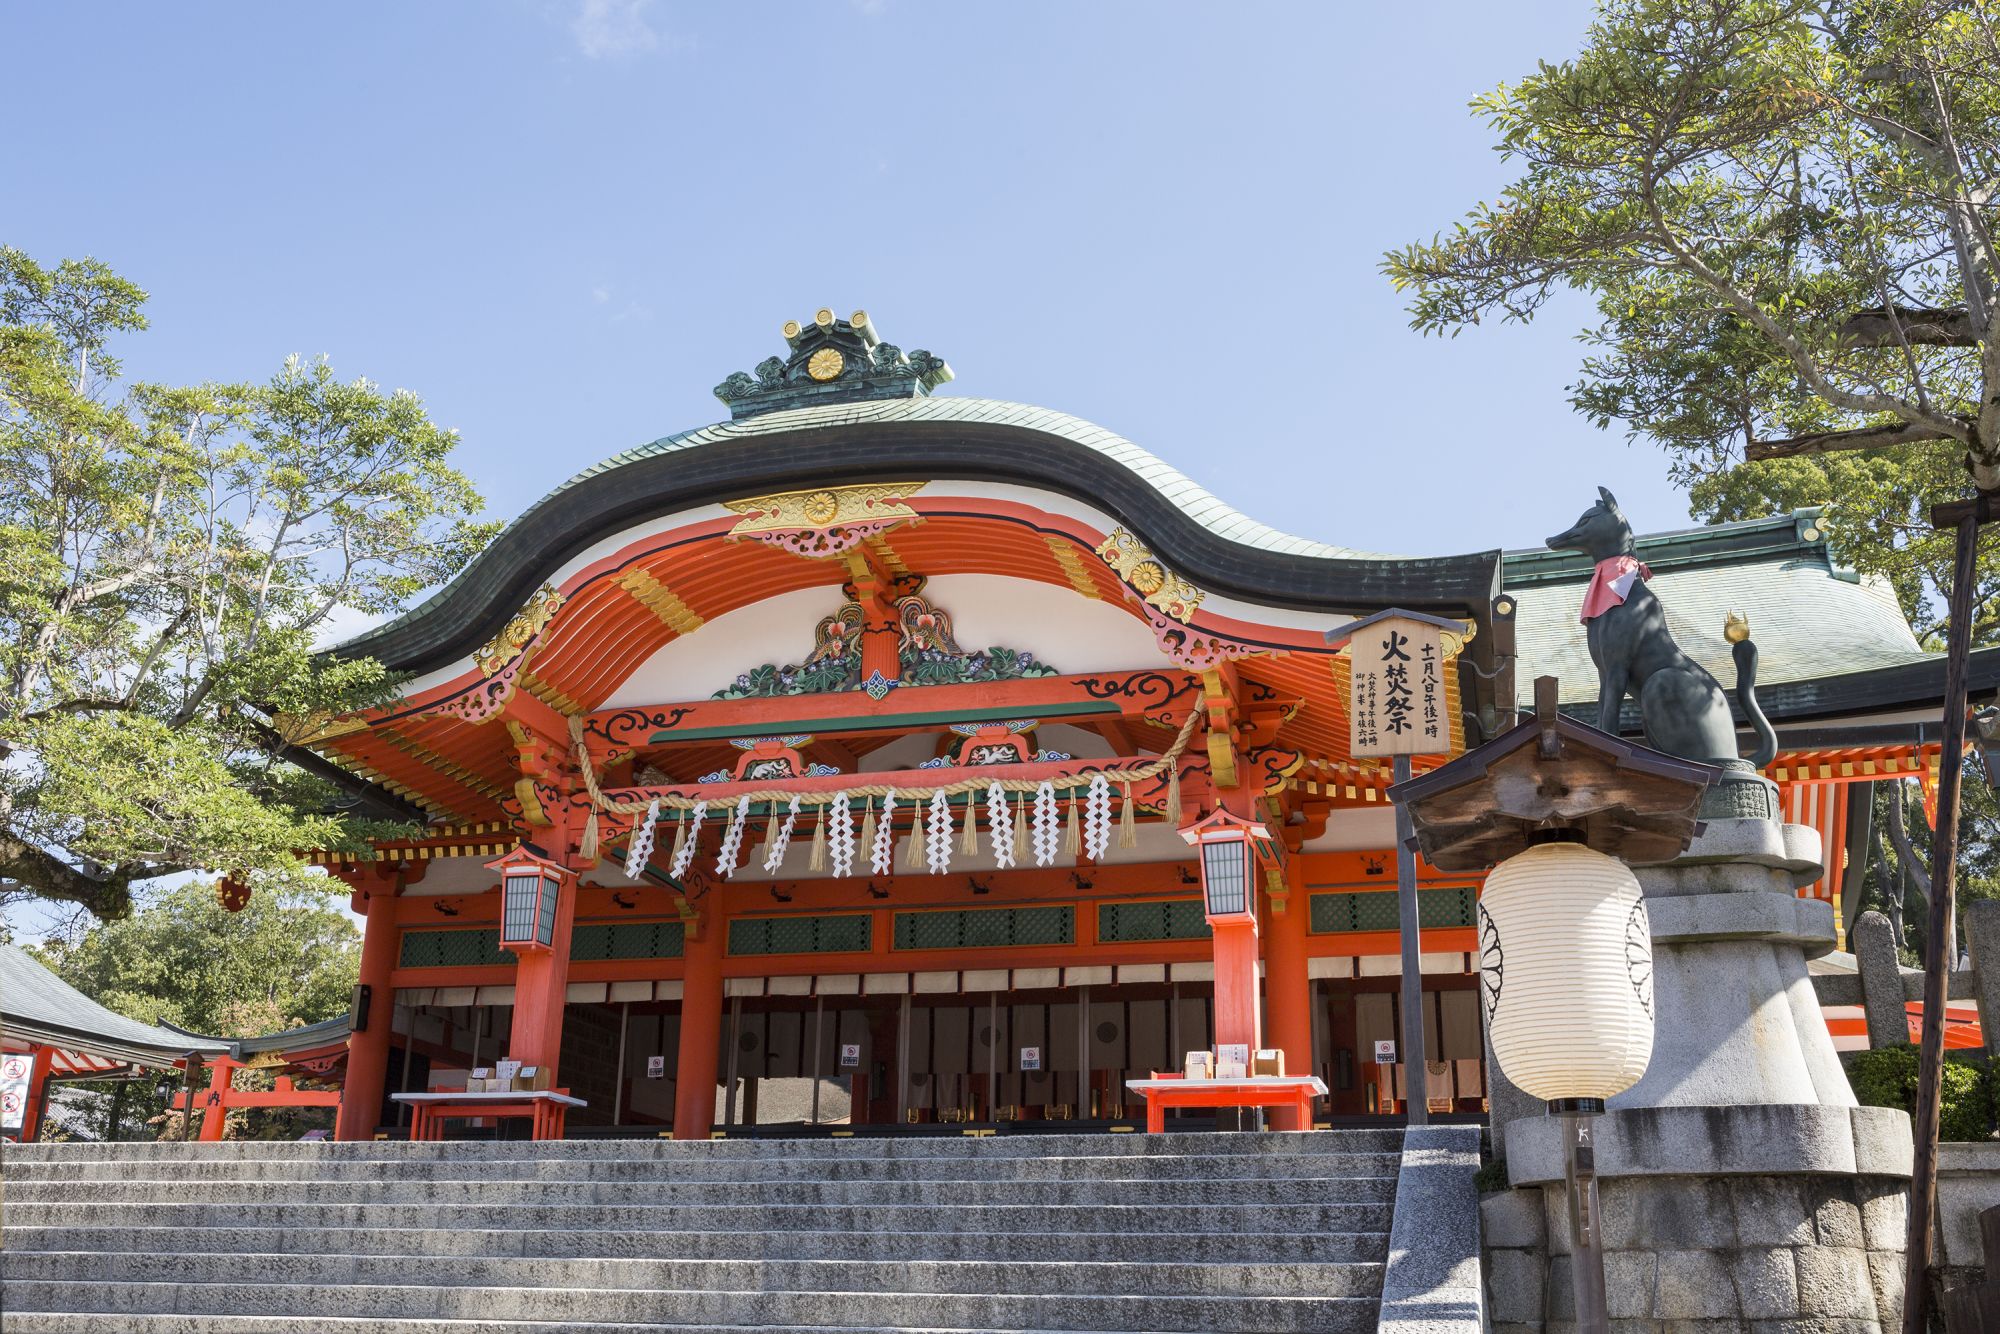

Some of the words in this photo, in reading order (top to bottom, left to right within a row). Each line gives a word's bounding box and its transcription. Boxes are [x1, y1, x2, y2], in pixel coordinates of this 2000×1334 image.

[1381, 630, 1415, 735] 火焚祭
[1421, 643, 1439, 739] 十一月八日午後一時
